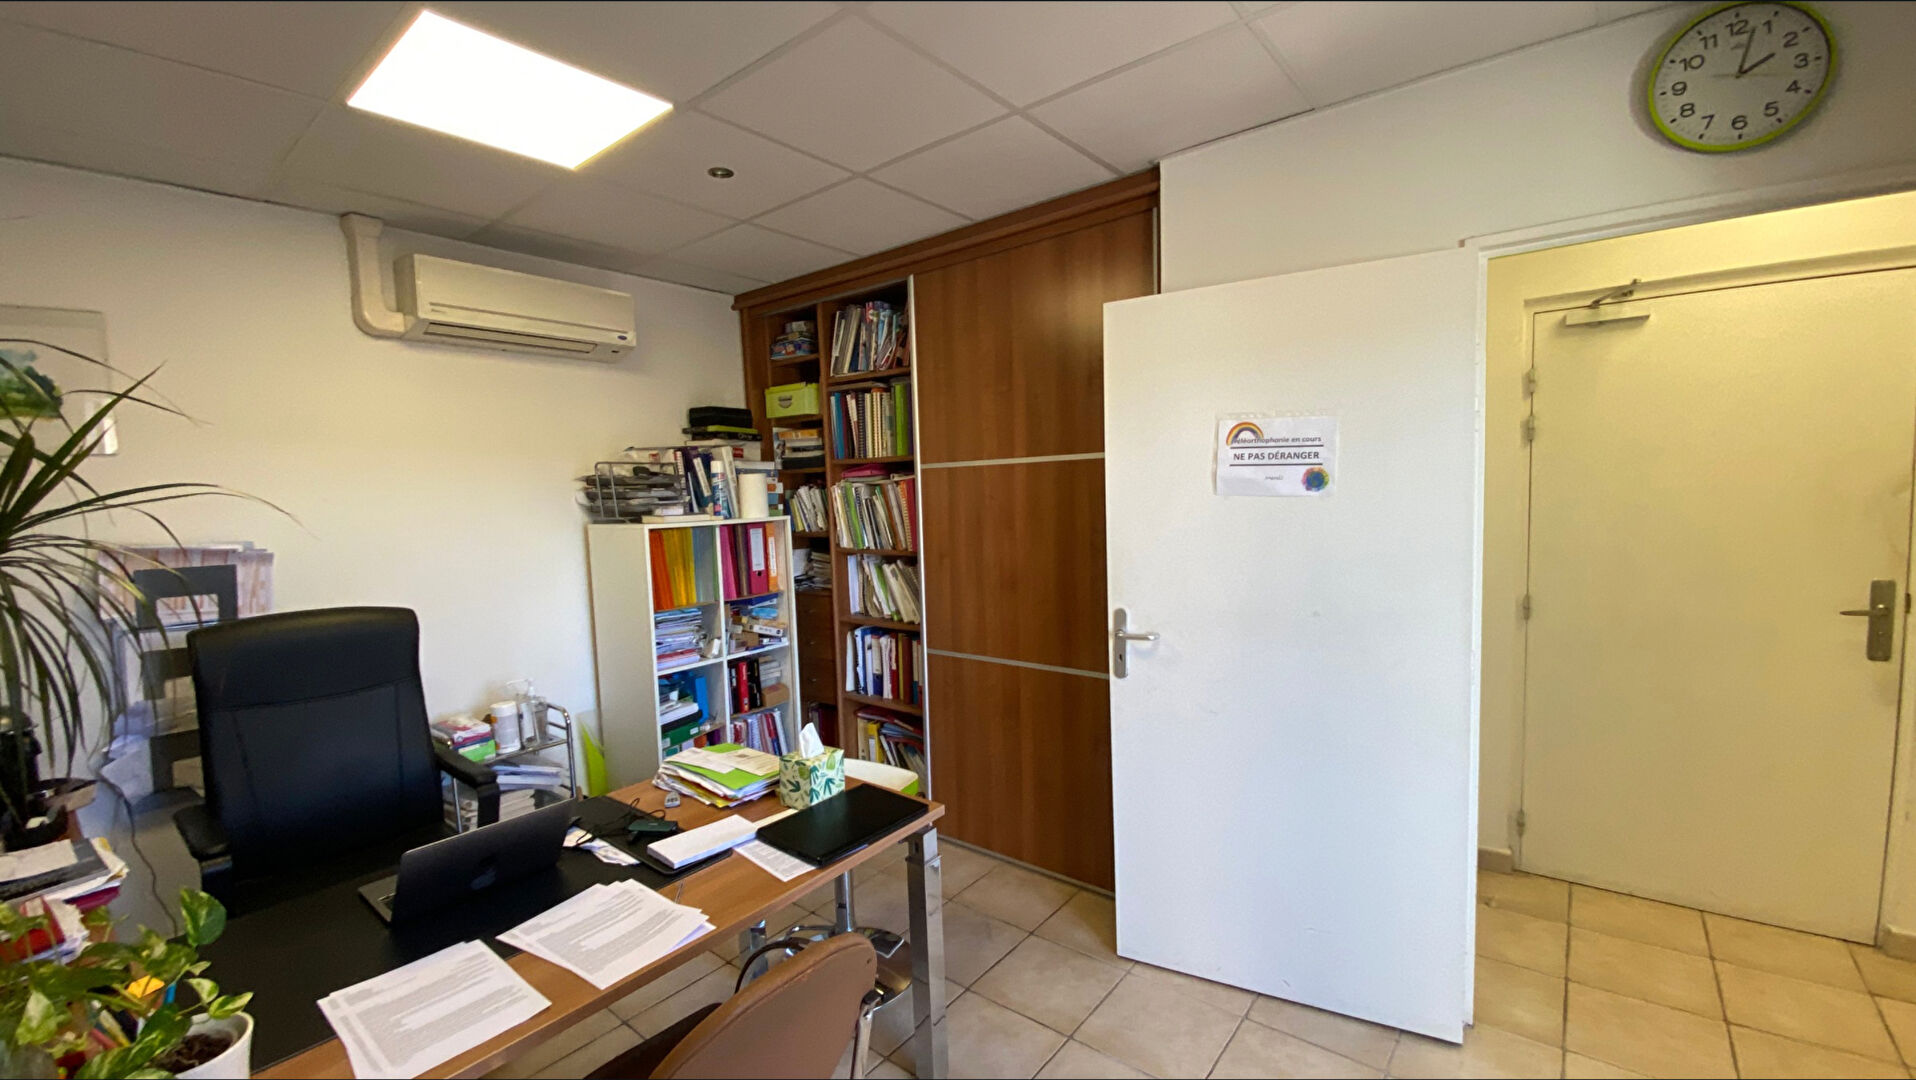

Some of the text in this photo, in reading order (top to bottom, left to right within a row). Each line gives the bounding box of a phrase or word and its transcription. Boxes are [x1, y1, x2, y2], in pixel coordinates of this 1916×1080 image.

[1725, 19, 1750, 37] 12
[1762, 19, 1772, 34] 1
[1700, 34, 1718, 49] 11
[1783, 31, 1799, 48] 2
[1679, 54, 1705, 71] 10
[1793, 52, 1809, 69] 3
[1671, 81, 1687, 97] 9
[1785, 80, 1802, 94] 4
[1680, 102, 1695, 118] 8
[1763, 101, 1779, 117] 5
[1701, 114, 1716, 130] 7
[1731, 115, 1748, 130] 6
[1233, 450, 1320, 461] NE PAS DÉRANGER
